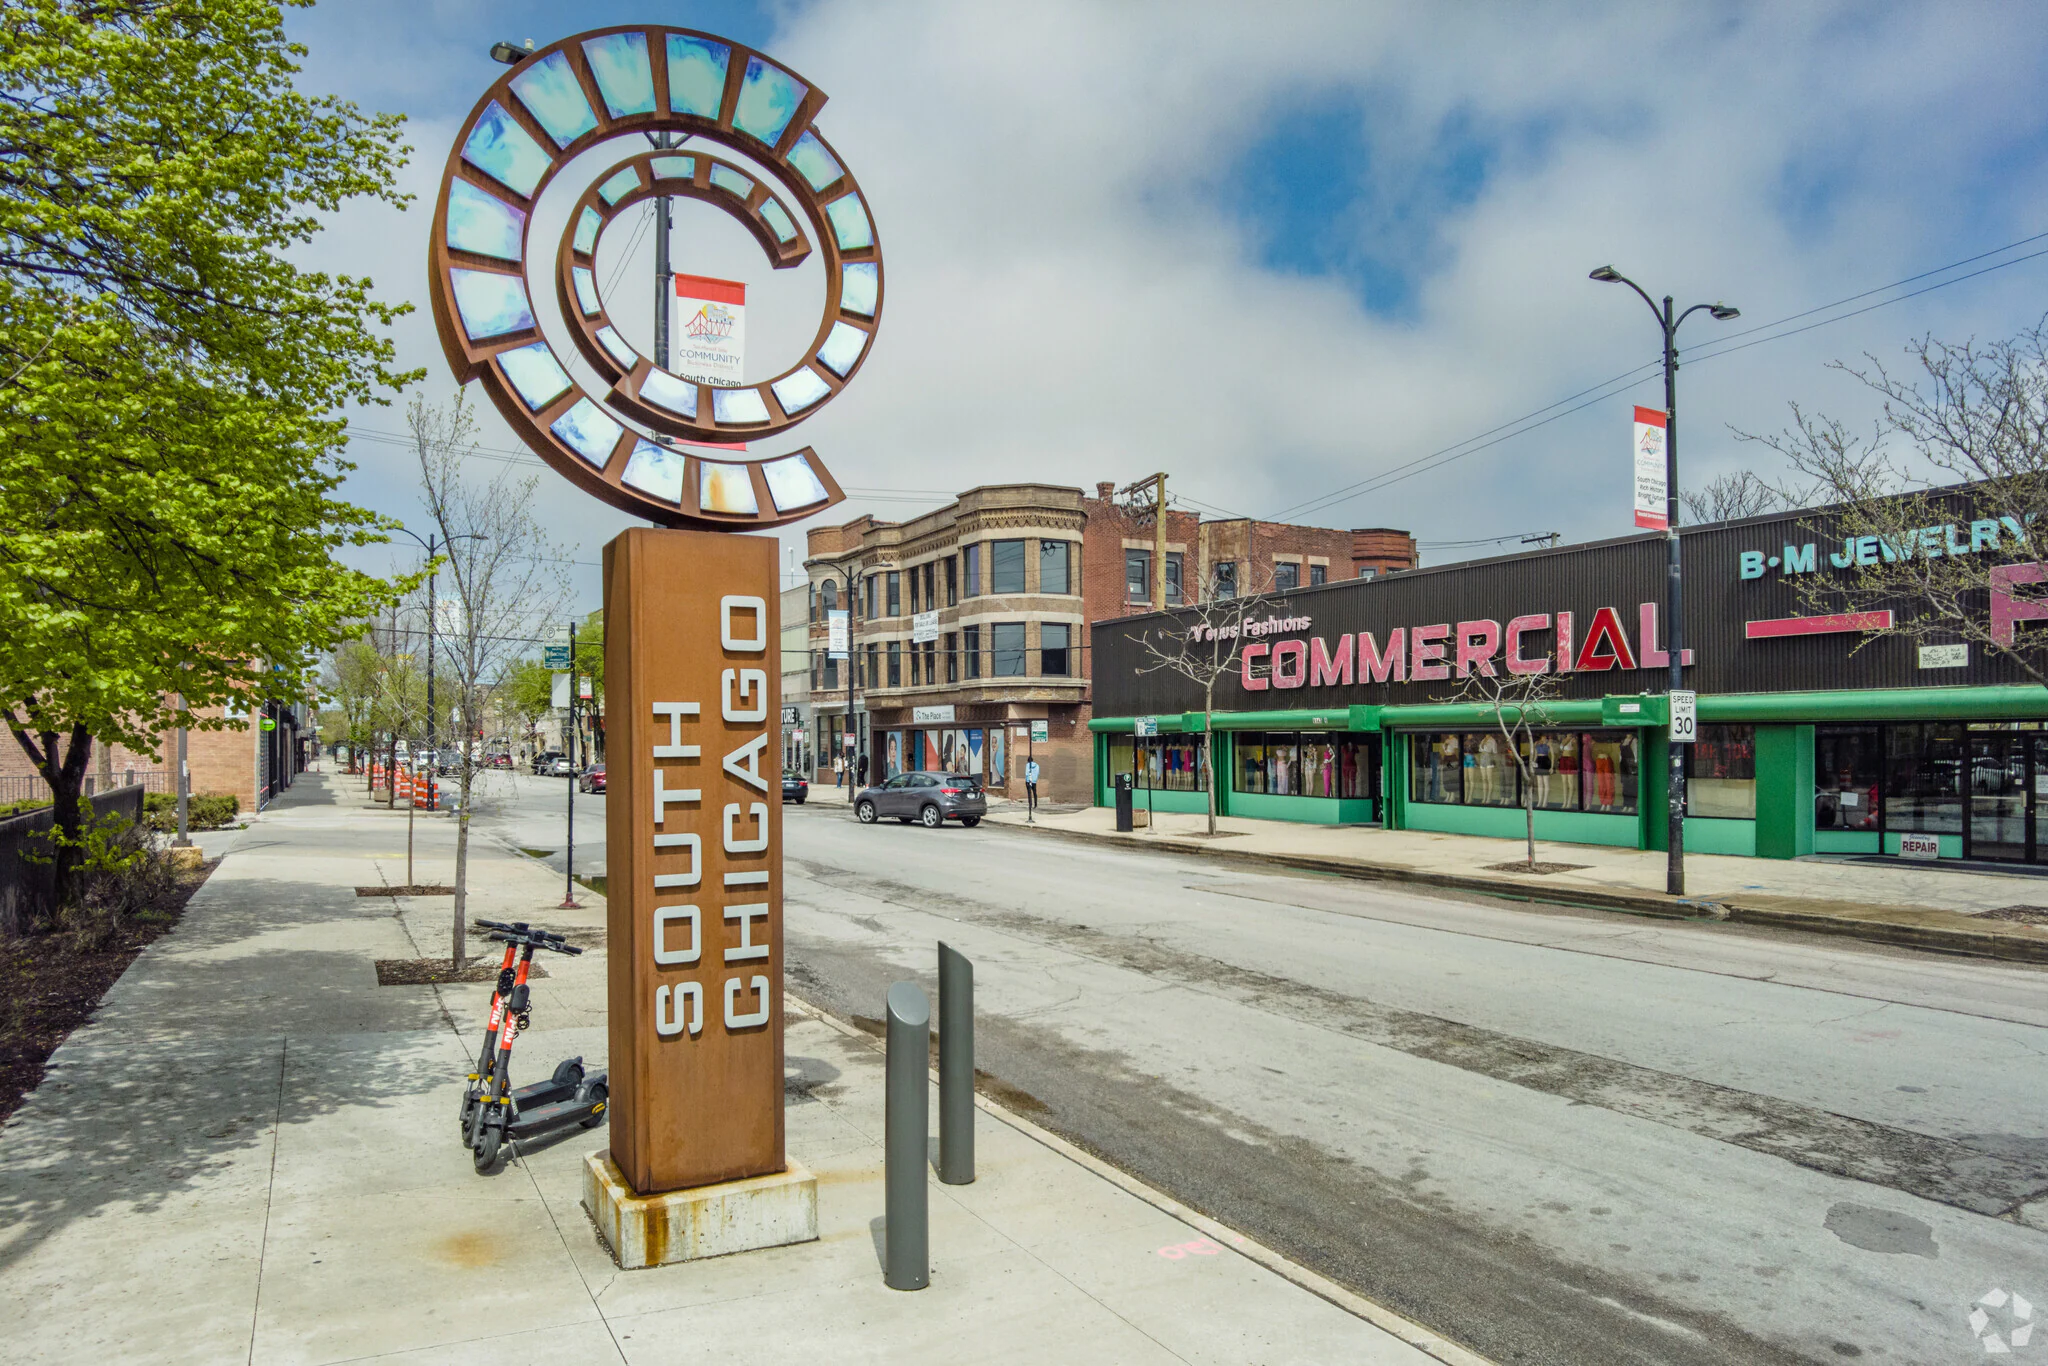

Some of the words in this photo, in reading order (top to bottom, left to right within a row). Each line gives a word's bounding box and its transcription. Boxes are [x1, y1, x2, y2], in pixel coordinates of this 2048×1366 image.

[679, 349, 741, 364] COMMUNITY
[680, 373, 706, 383] South
[708, 376, 742, 388] Chicago
[1243, 615, 1312, 637] Fashions
[1241, 602, 1696, 691] COMMERCIAL
[1672, 695, 1694, 704] SPEED
[1675, 706, 1692, 714] LIMIT
[1674, 716, 1693, 735] 30
[720, 595, 770, 1029] CHICAGO
[1902, 841, 1937, 852] REPAIR
[652, 701, 703, 1037] SOUTH
